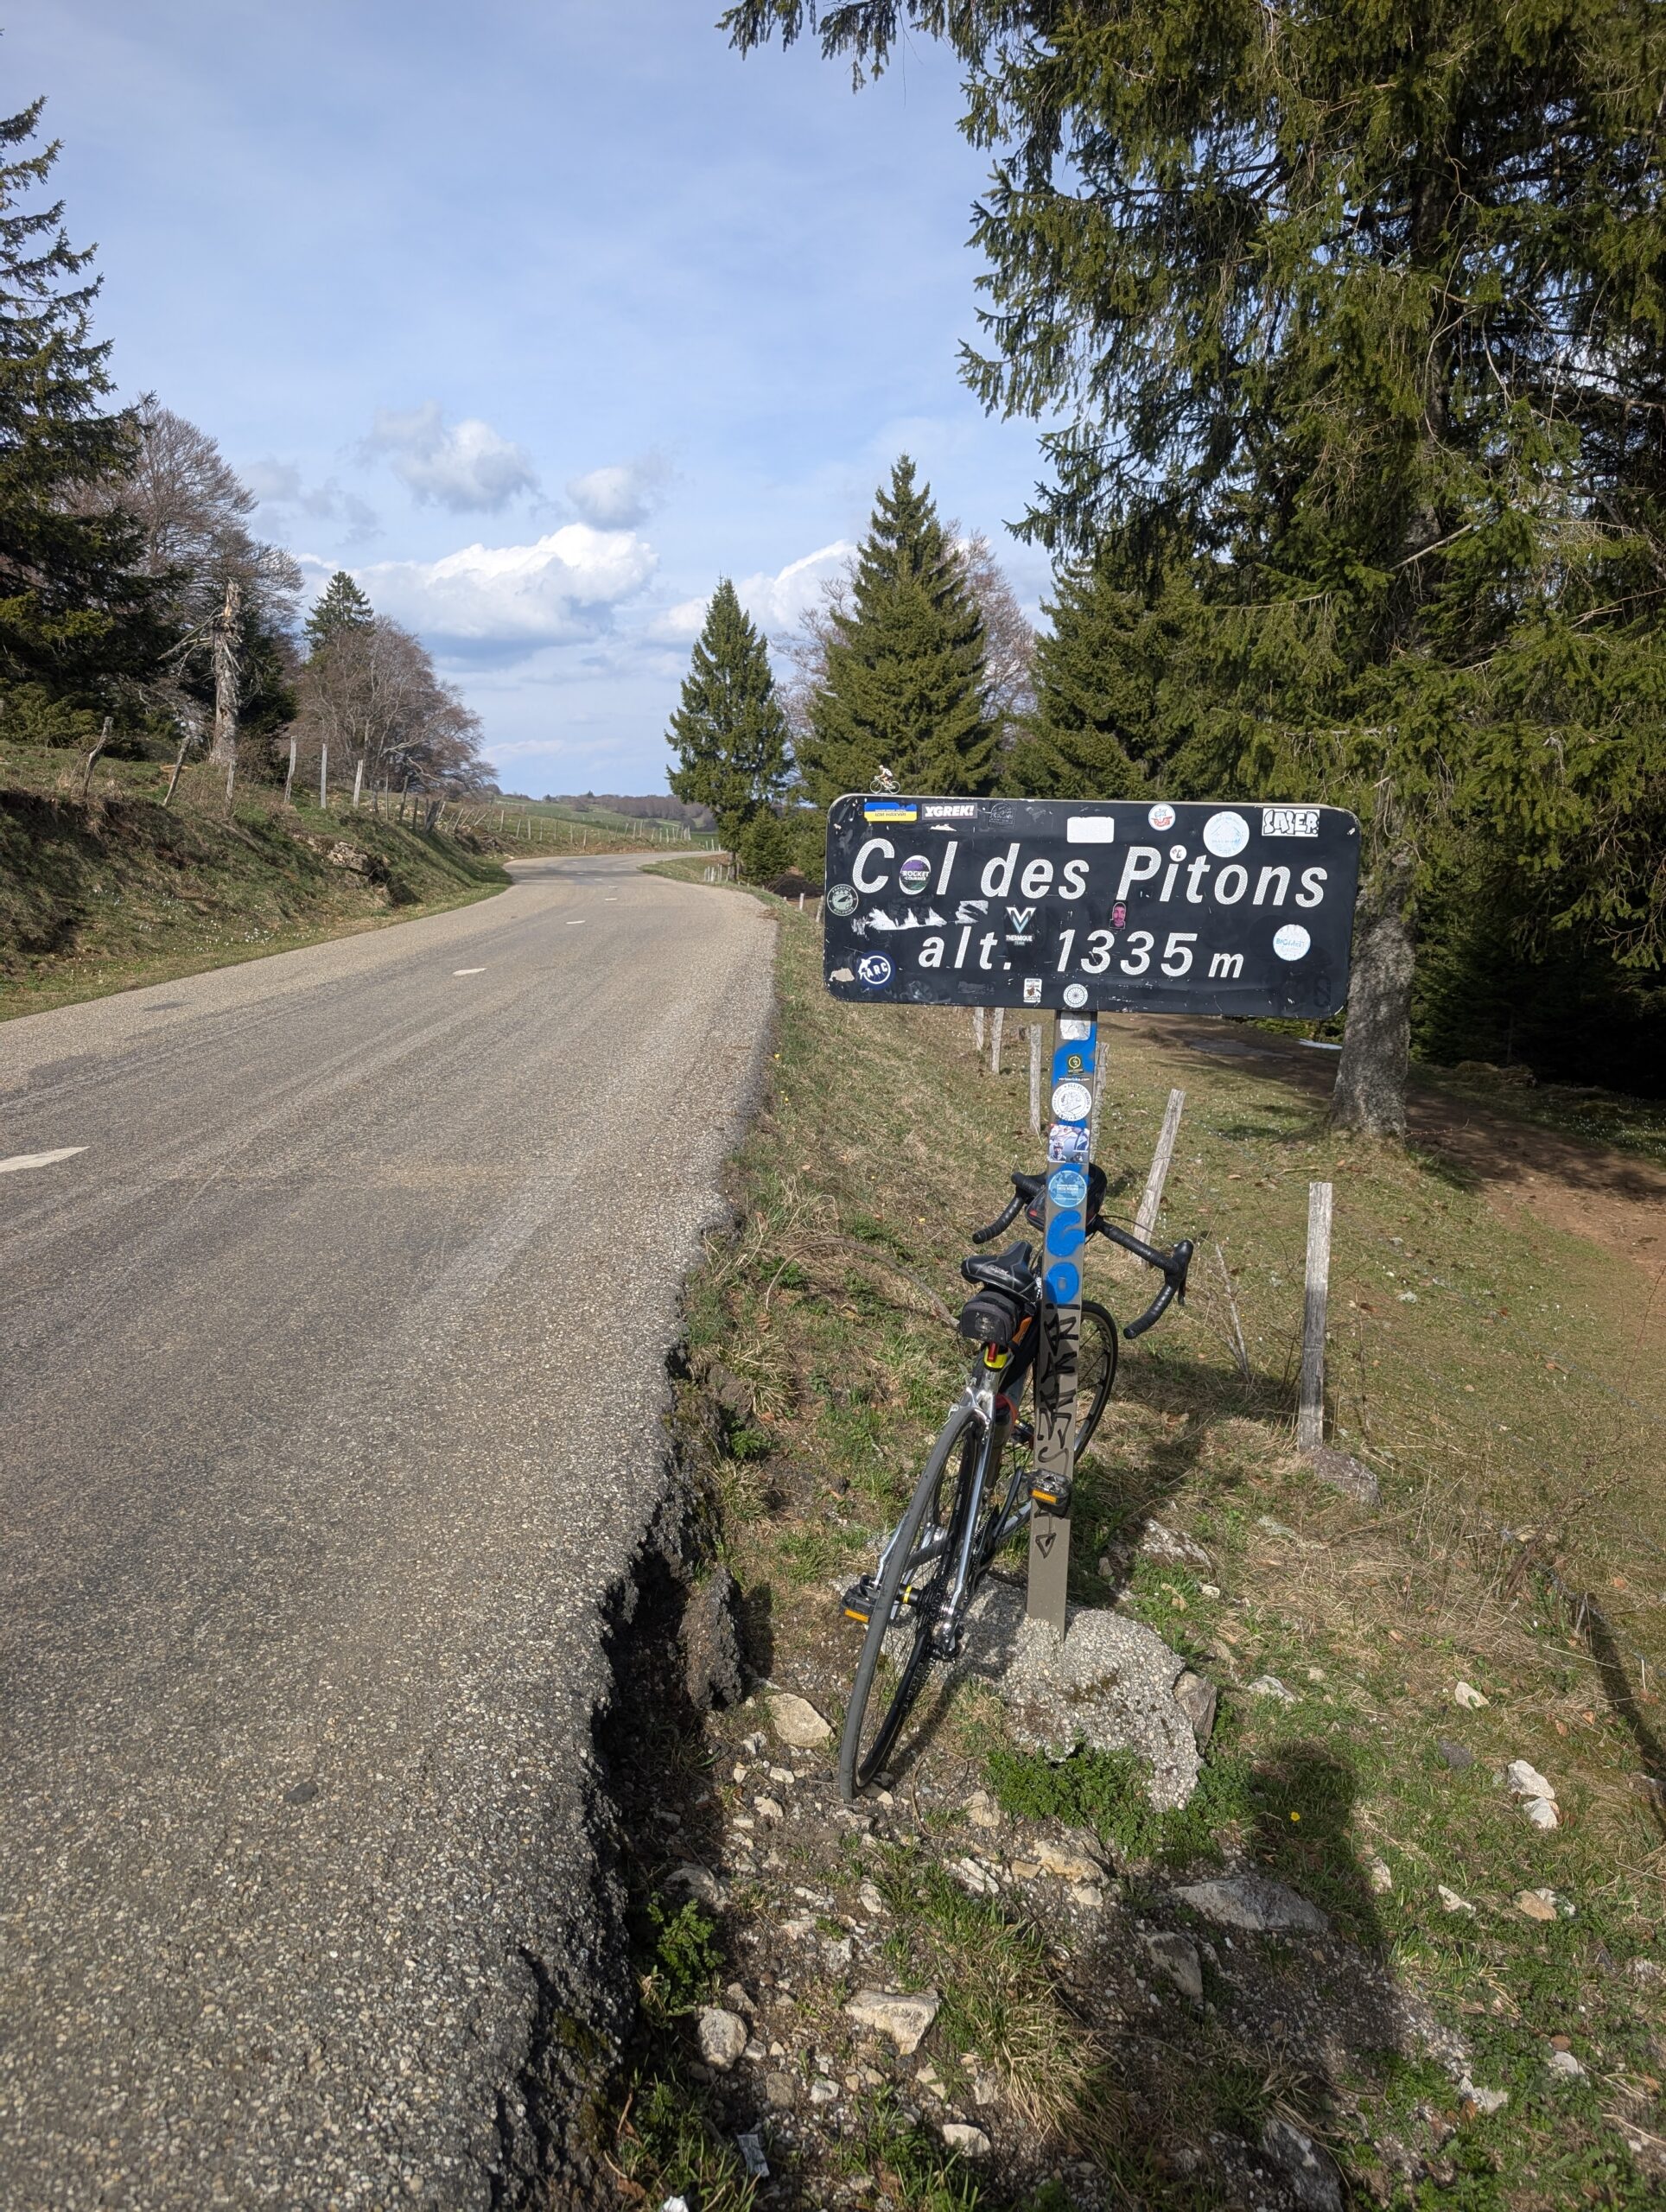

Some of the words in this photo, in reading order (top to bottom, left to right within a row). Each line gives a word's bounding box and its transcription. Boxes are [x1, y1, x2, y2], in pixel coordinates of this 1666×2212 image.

[925, 804, 975, 817] YGREK!
[853, 838, 958, 895] Col
[981, 842, 1090, 899] des
[1116, 847, 1328, 908] Pitons
[919, 926, 1012, 969] alt.
[1057, 929, 1199, 977] 1335
[1208, 953, 1244, 978] m
[866, 963, 888, 978] ARC
